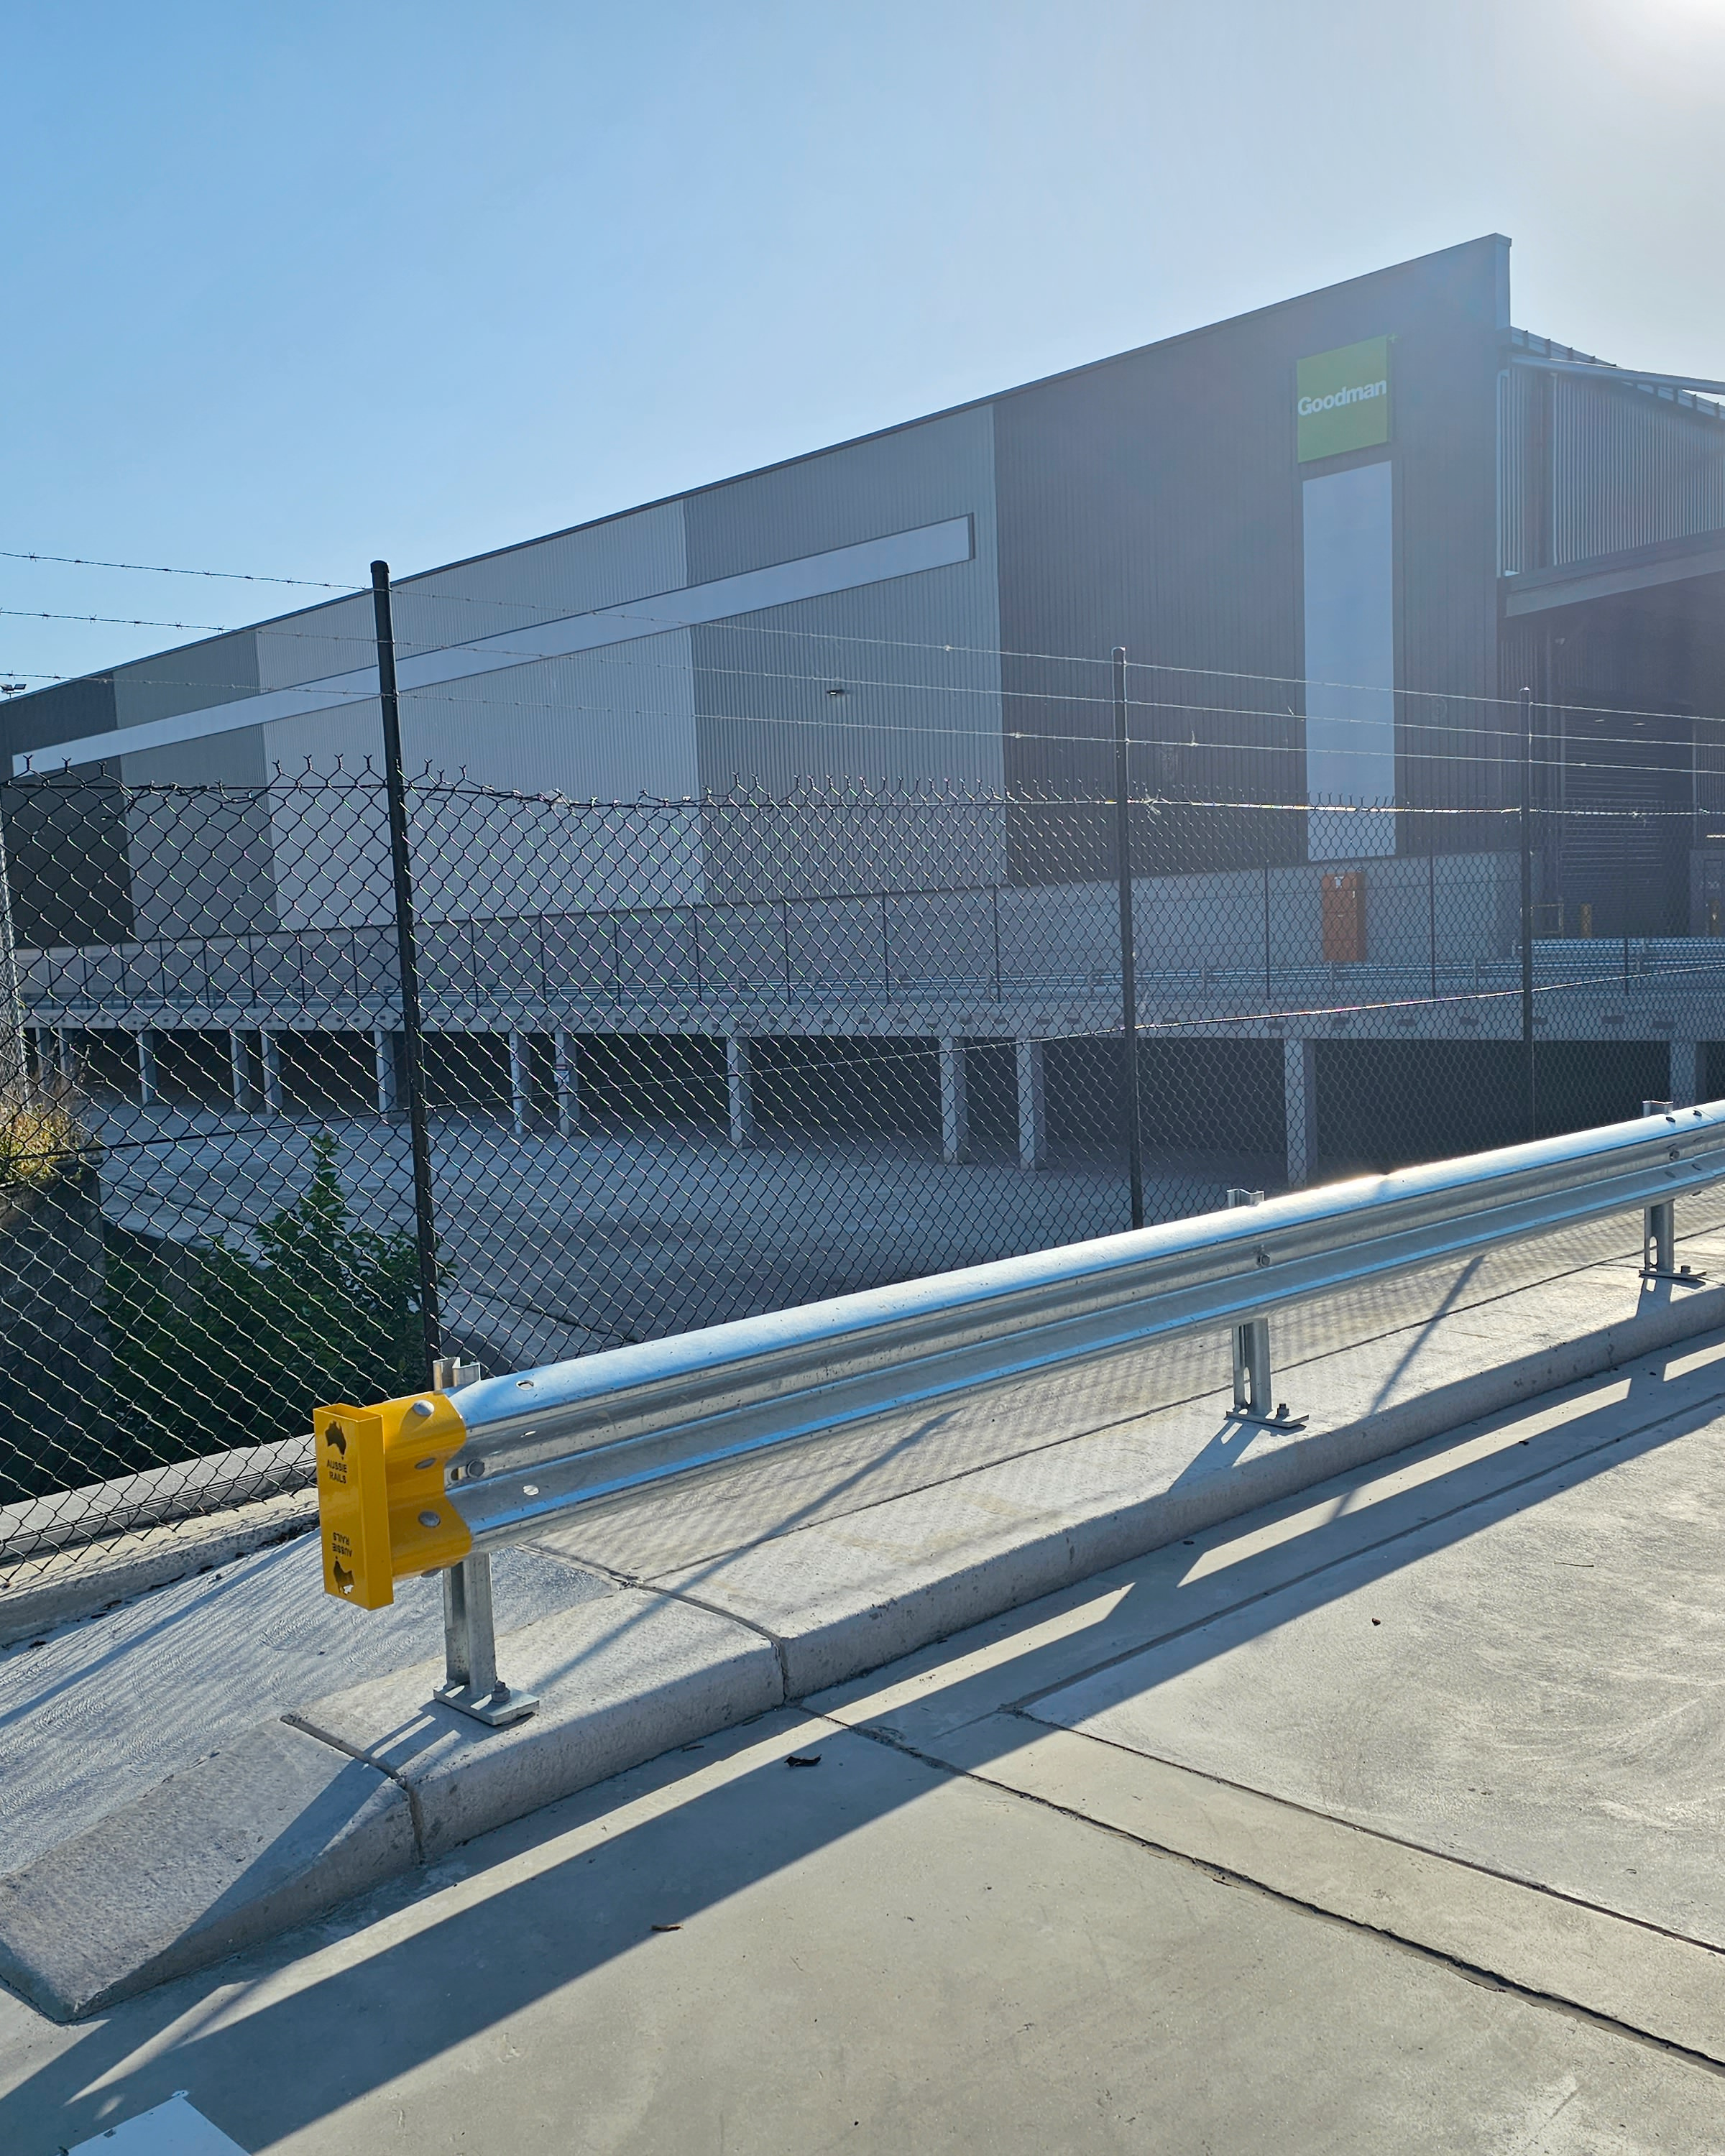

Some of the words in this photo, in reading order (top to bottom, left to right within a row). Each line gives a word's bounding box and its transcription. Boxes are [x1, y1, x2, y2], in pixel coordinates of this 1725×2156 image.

[1298, 379, 1387, 415] Goodman
[326, 1459, 348, 1473] AUSSIE
[328, 1471, 346, 1484] RAILS
[333, 1532, 350, 1546] RAILS
[331, 1543, 352, 1557] AUSSIE
